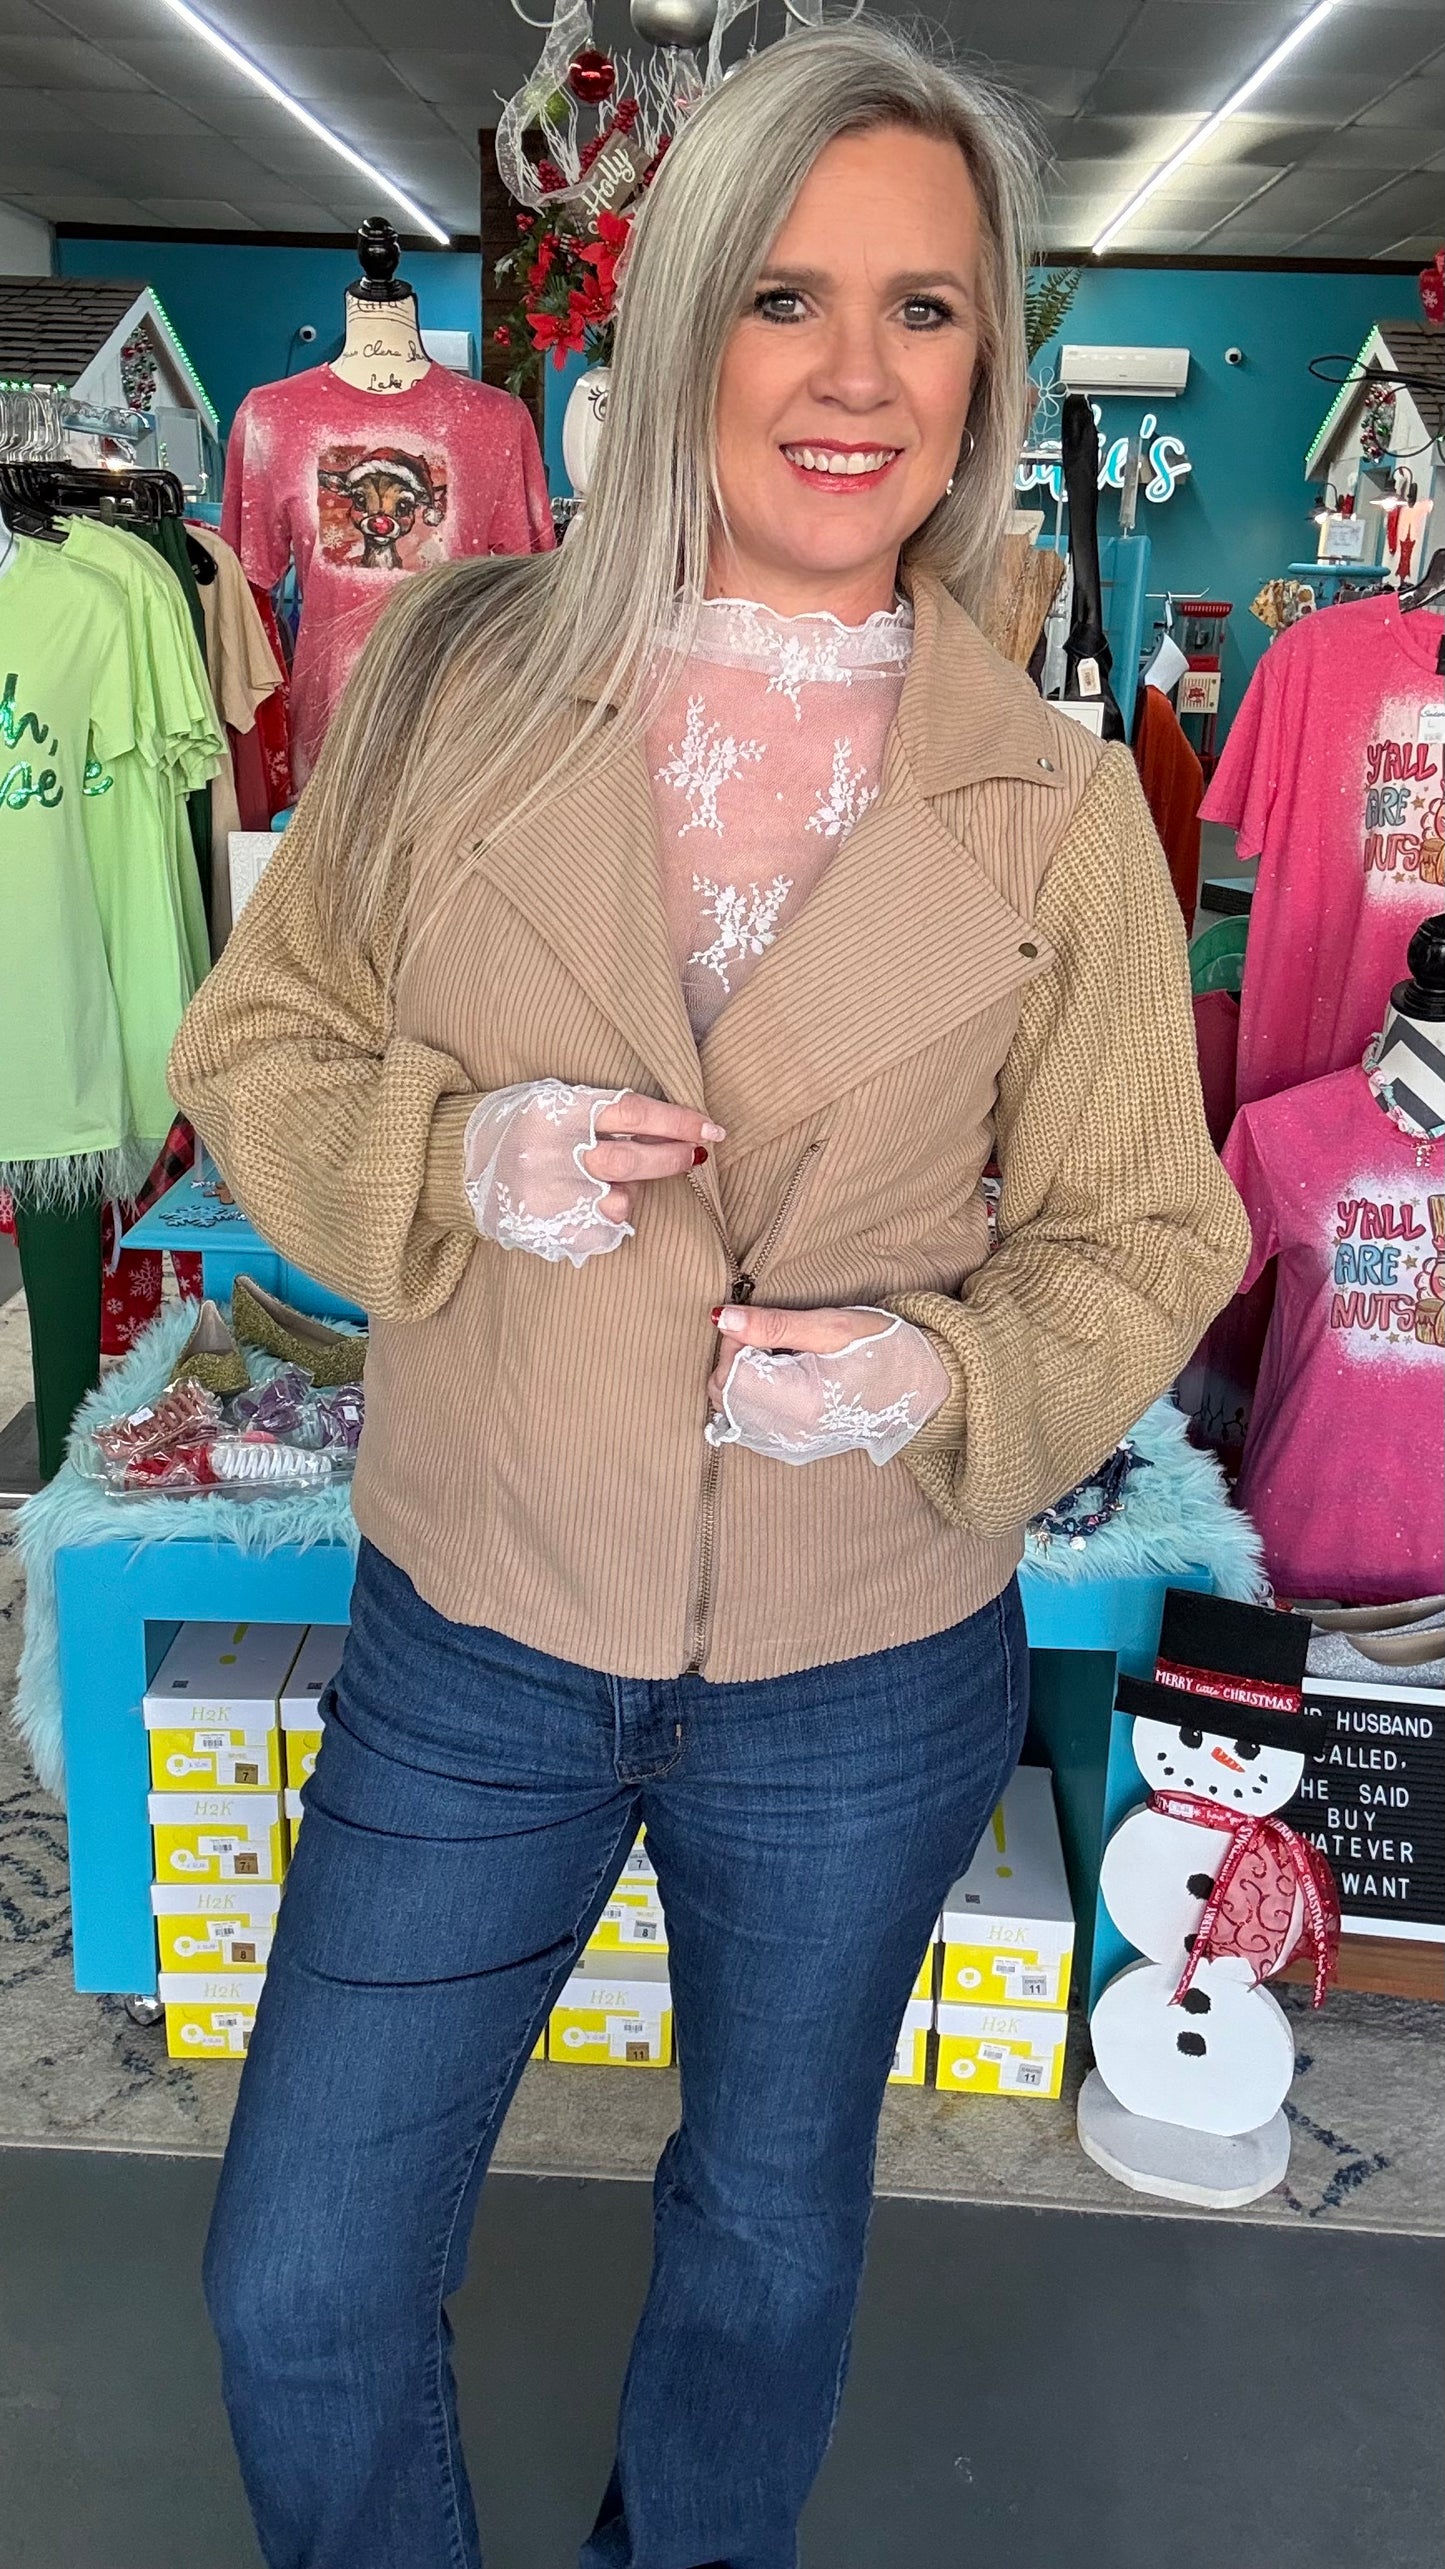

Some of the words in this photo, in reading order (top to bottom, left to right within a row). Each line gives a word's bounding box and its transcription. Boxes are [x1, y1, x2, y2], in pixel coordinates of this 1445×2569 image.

[581, 148, 636, 217] Holly
[1366, 739, 1437, 785] Y'ALL
[1365, 787, 1411, 829] ARE
[1364, 833, 1421, 872] NUTS
[1336, 1197, 1426, 1242] Y'ALL
[1334, 1243, 1400, 1286] ARE
[1330, 1291, 1415, 1332] NUTS
[1154, 1669, 1193, 1691] MERRY
[191, 1706, 231, 1721] H2K
[1336, 1710, 1433, 1738] HUSBAND
[243, 1772, 249, 1782] 7
[1359, 1784, 1409, 1808] SAID
[194, 1801, 234, 1816] H2K
[1327, 1807, 1376, 1832] BUY
[637, 1859, 643, 1869] 7
[1341, 1872, 1410, 1900] WANT
[197, 1894, 236, 1909] H2K
[1302, 1874, 1325, 1940] CHRISTMAS
[1199, 1906, 1217, 1939] MERRY
[642, 1928, 648, 1938] 8
[987, 1924, 1031, 1943] H2K
[240, 1950, 247, 1960] 8
[204, 1982, 242, 1998] H2K
[590, 1989, 628, 2006] H2K
[1029, 1984, 1041, 1994] 11
[981, 2016, 1022, 2033] H2K
[633, 2050, 644, 2060] 11
[1024, 2073, 1036, 2083] 11
